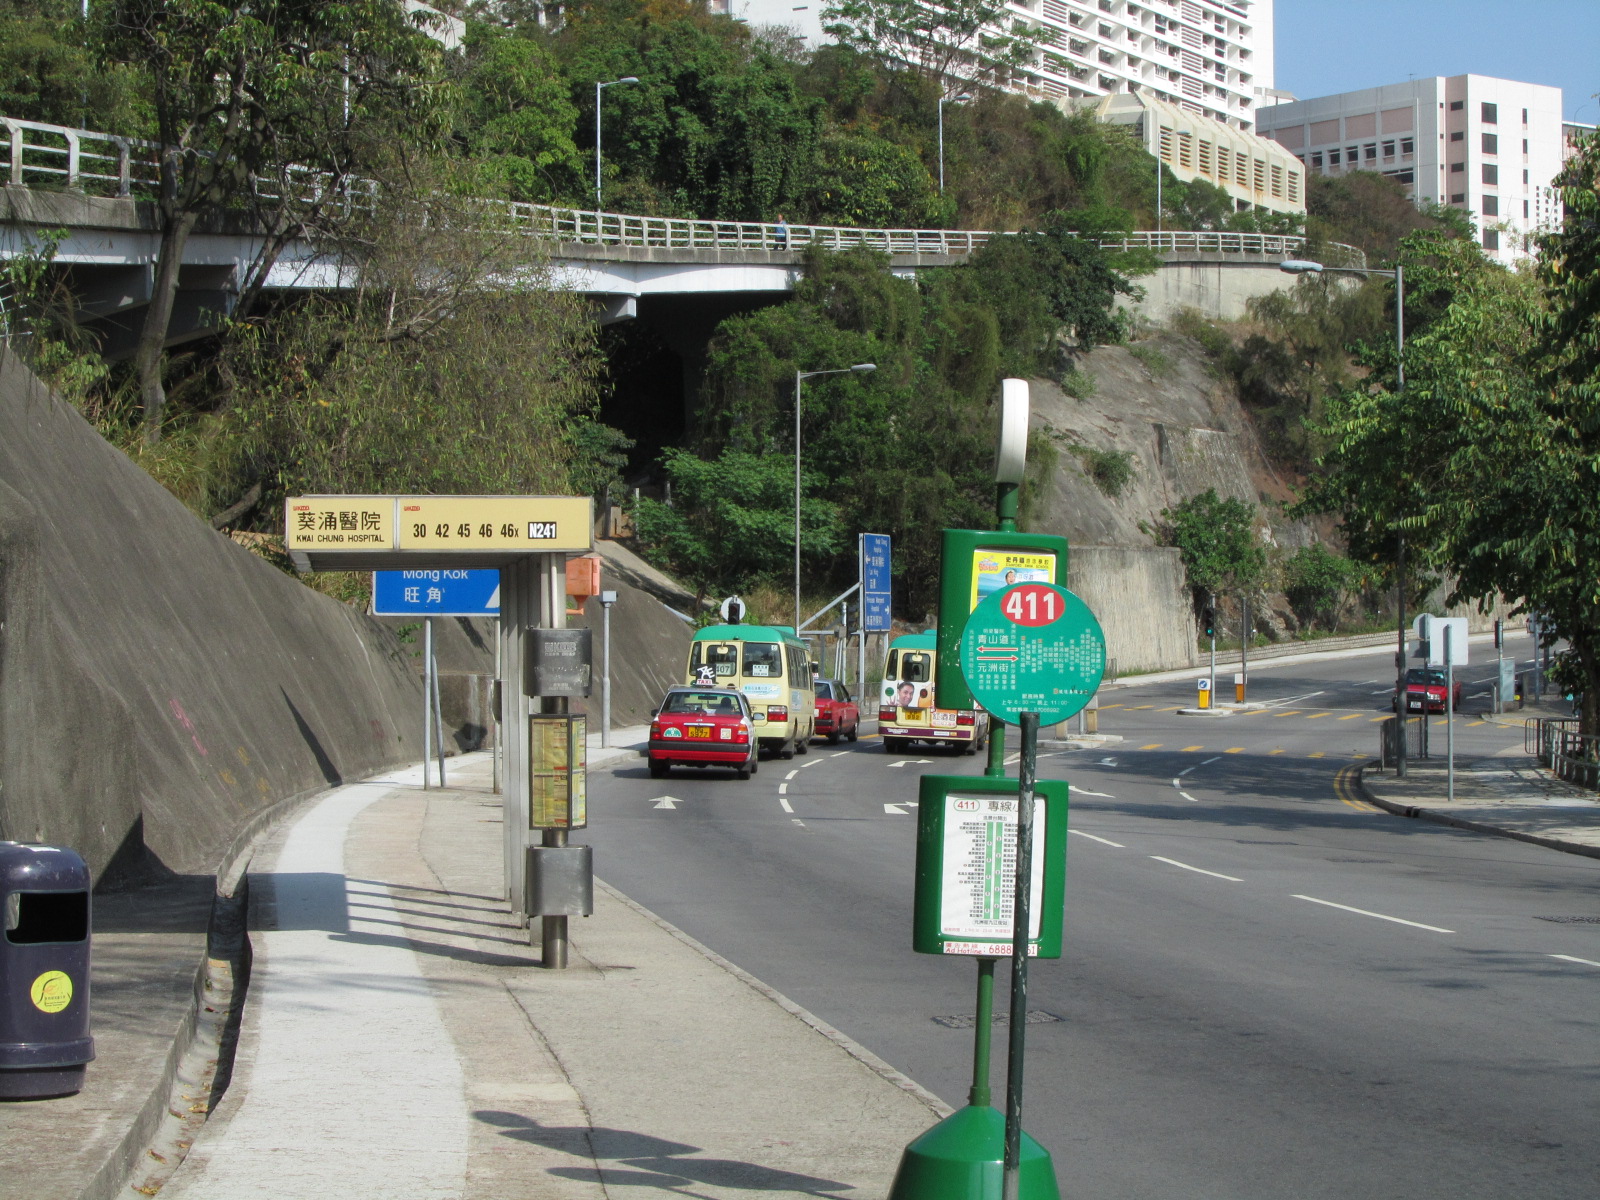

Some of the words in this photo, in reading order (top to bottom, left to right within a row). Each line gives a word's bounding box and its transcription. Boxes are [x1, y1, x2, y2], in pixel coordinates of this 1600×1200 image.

[298, 511, 381, 531] 葵涌醫院
[413, 523, 427, 538] 30
[435, 523, 449, 538] 42
[457, 523, 471, 538] 45
[479, 523, 493, 538] 46
[529, 523, 557, 538] N241
[296, 535, 314, 543] KWAI
[317, 535, 344, 543] CHUNG
[348, 535, 385, 543] HOSPITAL
[403, 570, 440, 582] Mong
[443, 570, 468, 579] Kok
[404, 586, 441, 603] 旺角
[1006, 592, 1055, 620] 411
[978, 634, 1009, 644] 青山道
[978, 662, 1009, 672] 元洲街
[958, 801, 976, 810] 411
